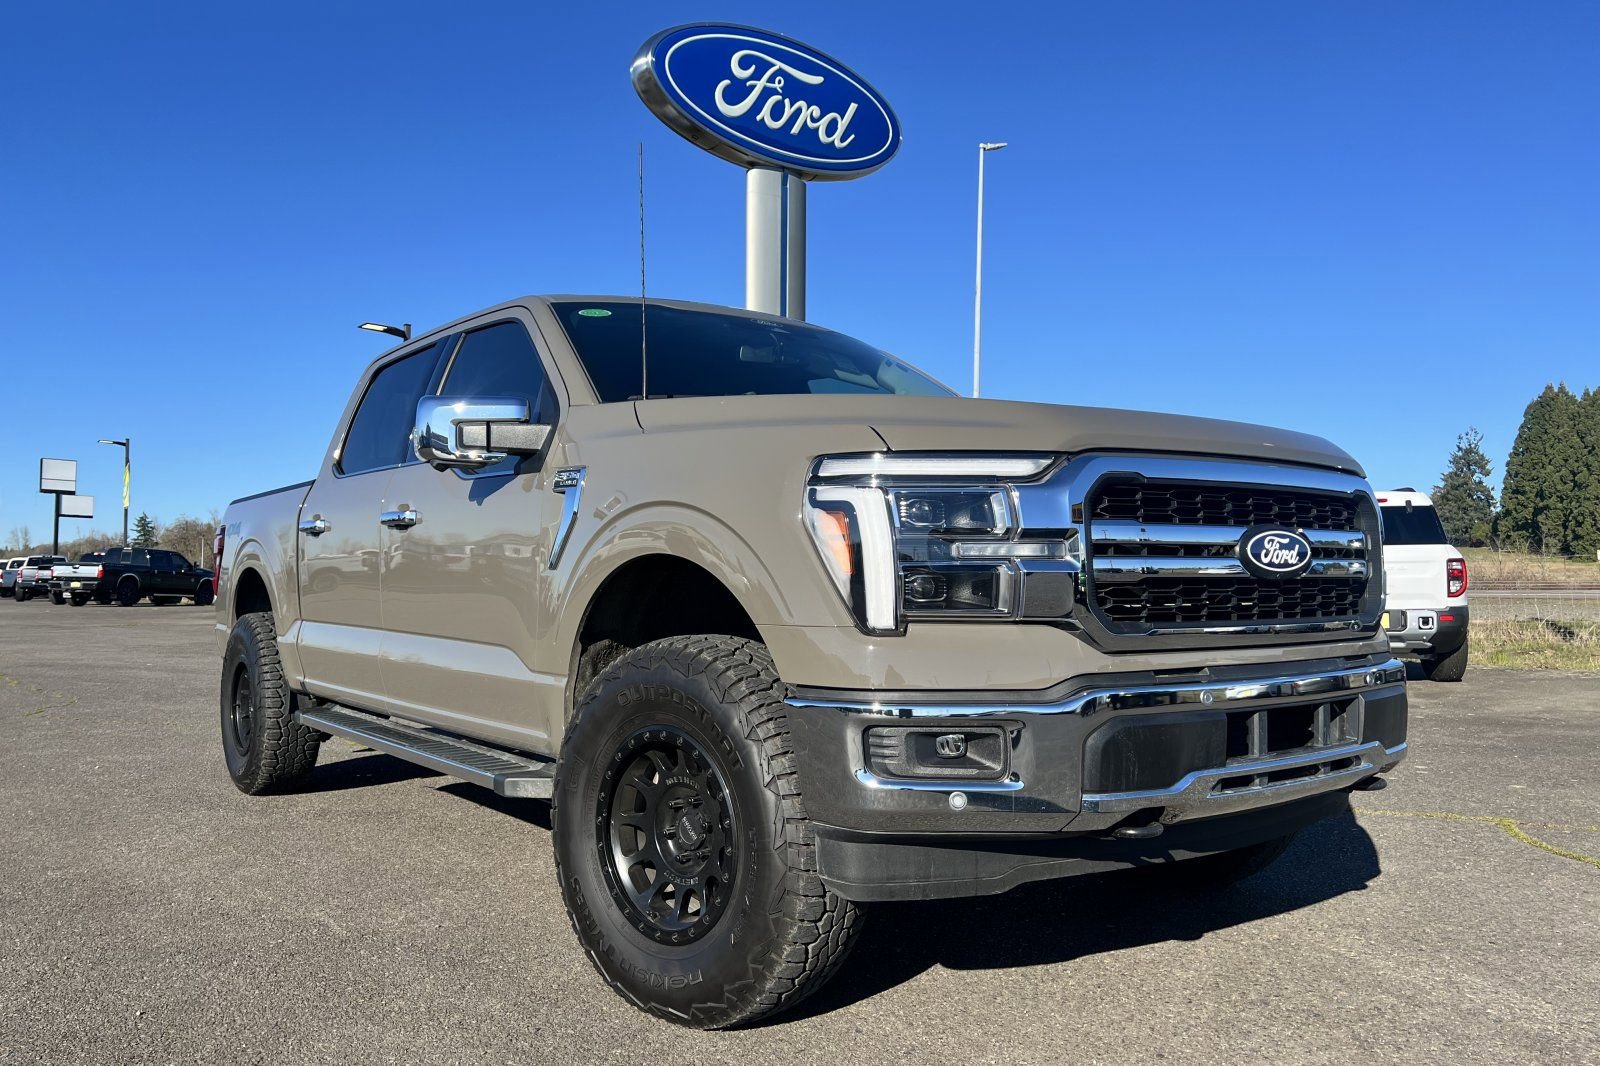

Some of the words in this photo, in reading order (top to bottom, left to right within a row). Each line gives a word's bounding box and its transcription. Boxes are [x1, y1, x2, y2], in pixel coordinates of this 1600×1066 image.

[715, 49, 859, 149] Ford
[1261, 535, 1300, 564] Ford
[615, 683, 712, 724] OUTPOST
[665, 776, 700, 789] METHOD
